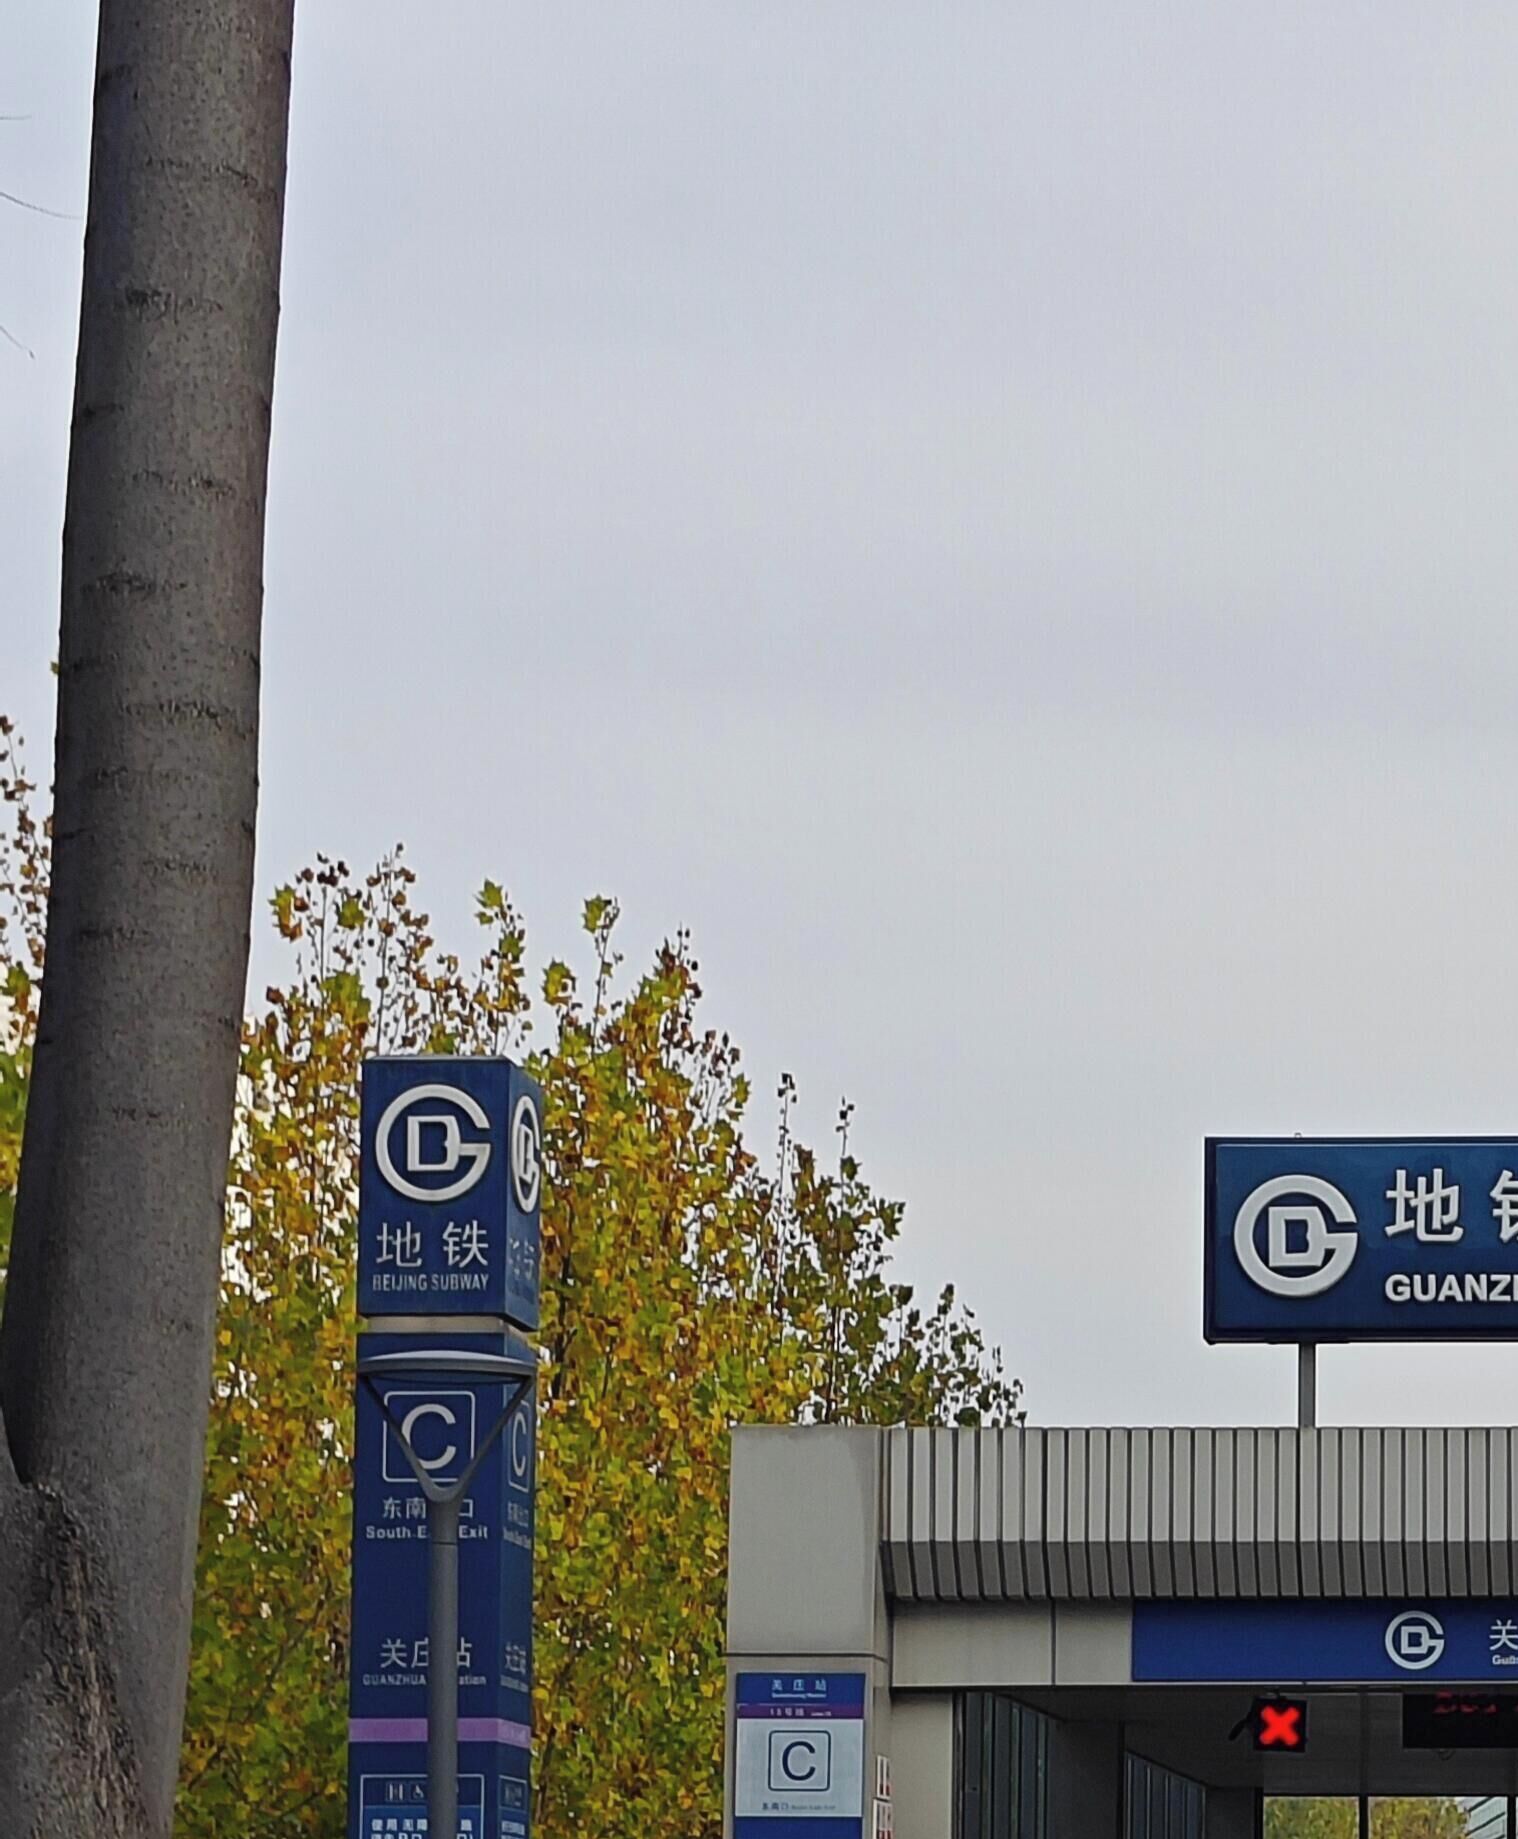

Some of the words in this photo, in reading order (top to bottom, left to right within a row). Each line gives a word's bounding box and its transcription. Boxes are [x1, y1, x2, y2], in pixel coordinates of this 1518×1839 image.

[376, 1219, 489, 1268] 地铁
[372, 1274, 428, 1291] BEIJING
[431, 1274, 490, 1291] SUBWAY
[401, 1403, 457, 1470] C
[512, 1411, 527, 1477] C
[458, 1525, 489, 1540] Exit
[781, 1740, 816, 1782] C
